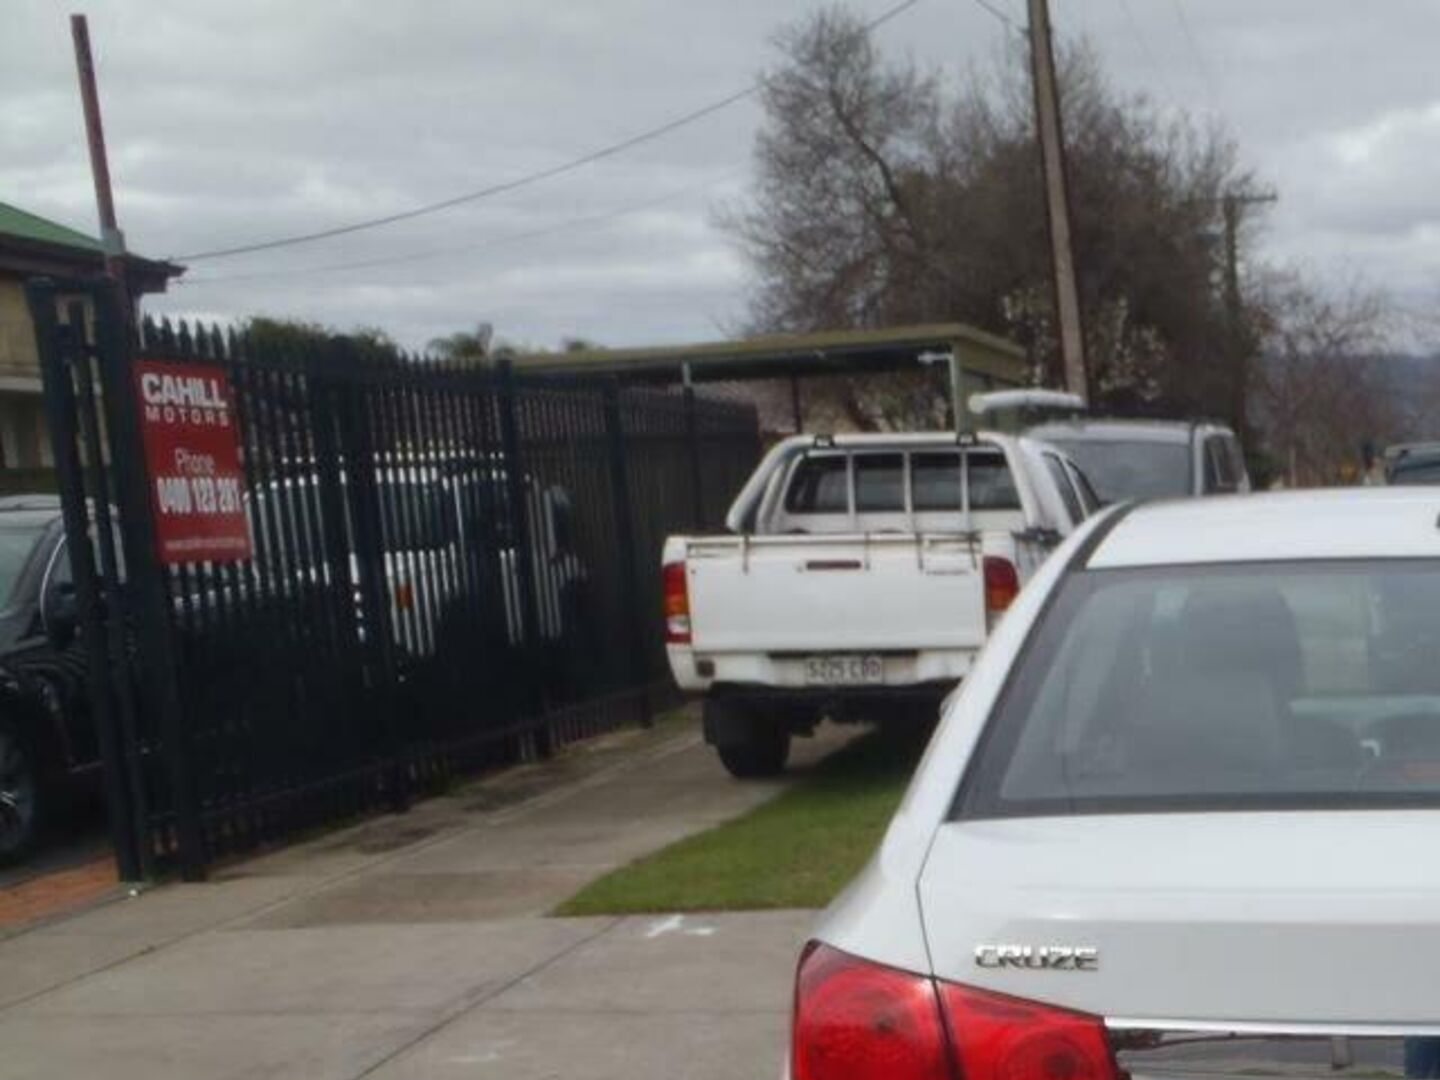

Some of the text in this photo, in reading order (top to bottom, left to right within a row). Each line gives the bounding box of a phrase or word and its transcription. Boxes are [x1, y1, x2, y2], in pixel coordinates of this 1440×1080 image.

[141, 373, 227, 408] CAHILL
[145, 405, 229, 427] MOTORS
[174, 448, 216, 475] Phone
[975, 943, 1098, 971] CRUZE
